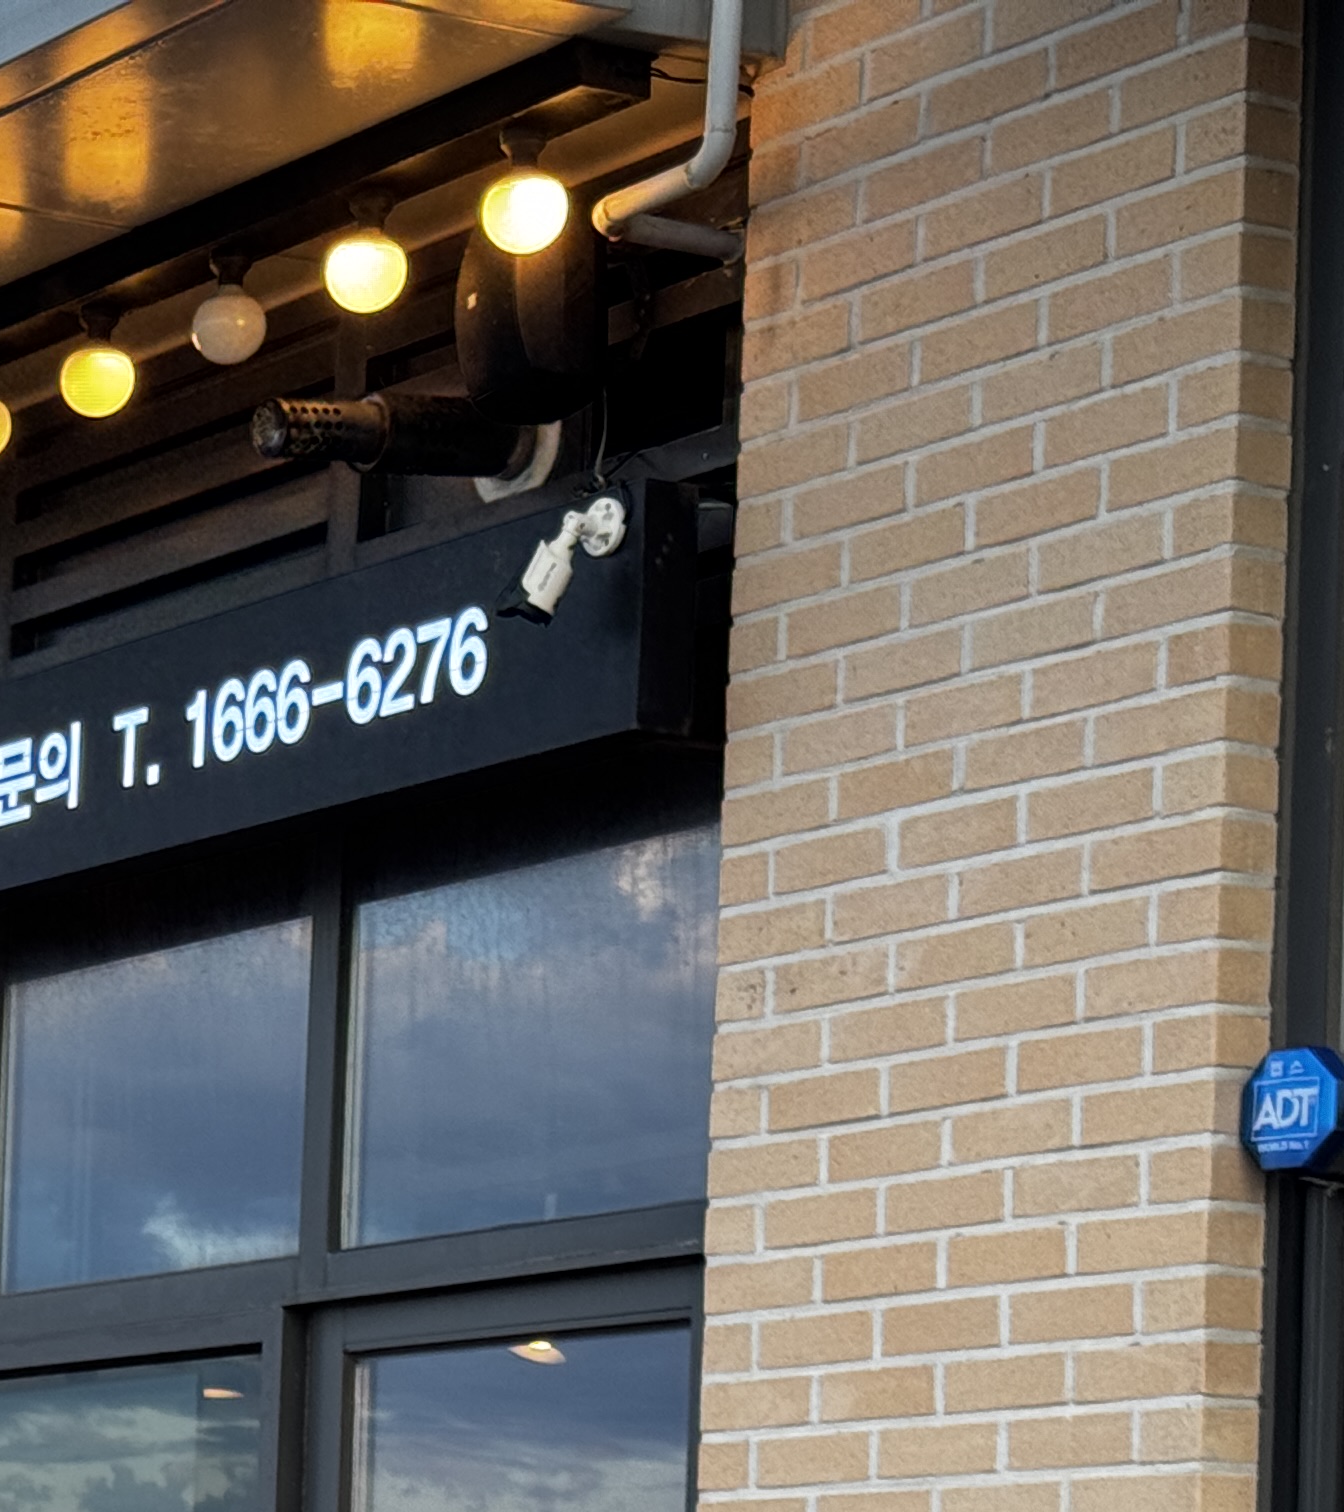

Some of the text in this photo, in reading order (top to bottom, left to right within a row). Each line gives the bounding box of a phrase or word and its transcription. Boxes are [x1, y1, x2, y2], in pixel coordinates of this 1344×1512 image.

[112, 706, 161, 790] T.
[185, 604, 490, 769] 1666-6276
[1252, 1086, 1320, 1132] ADT
